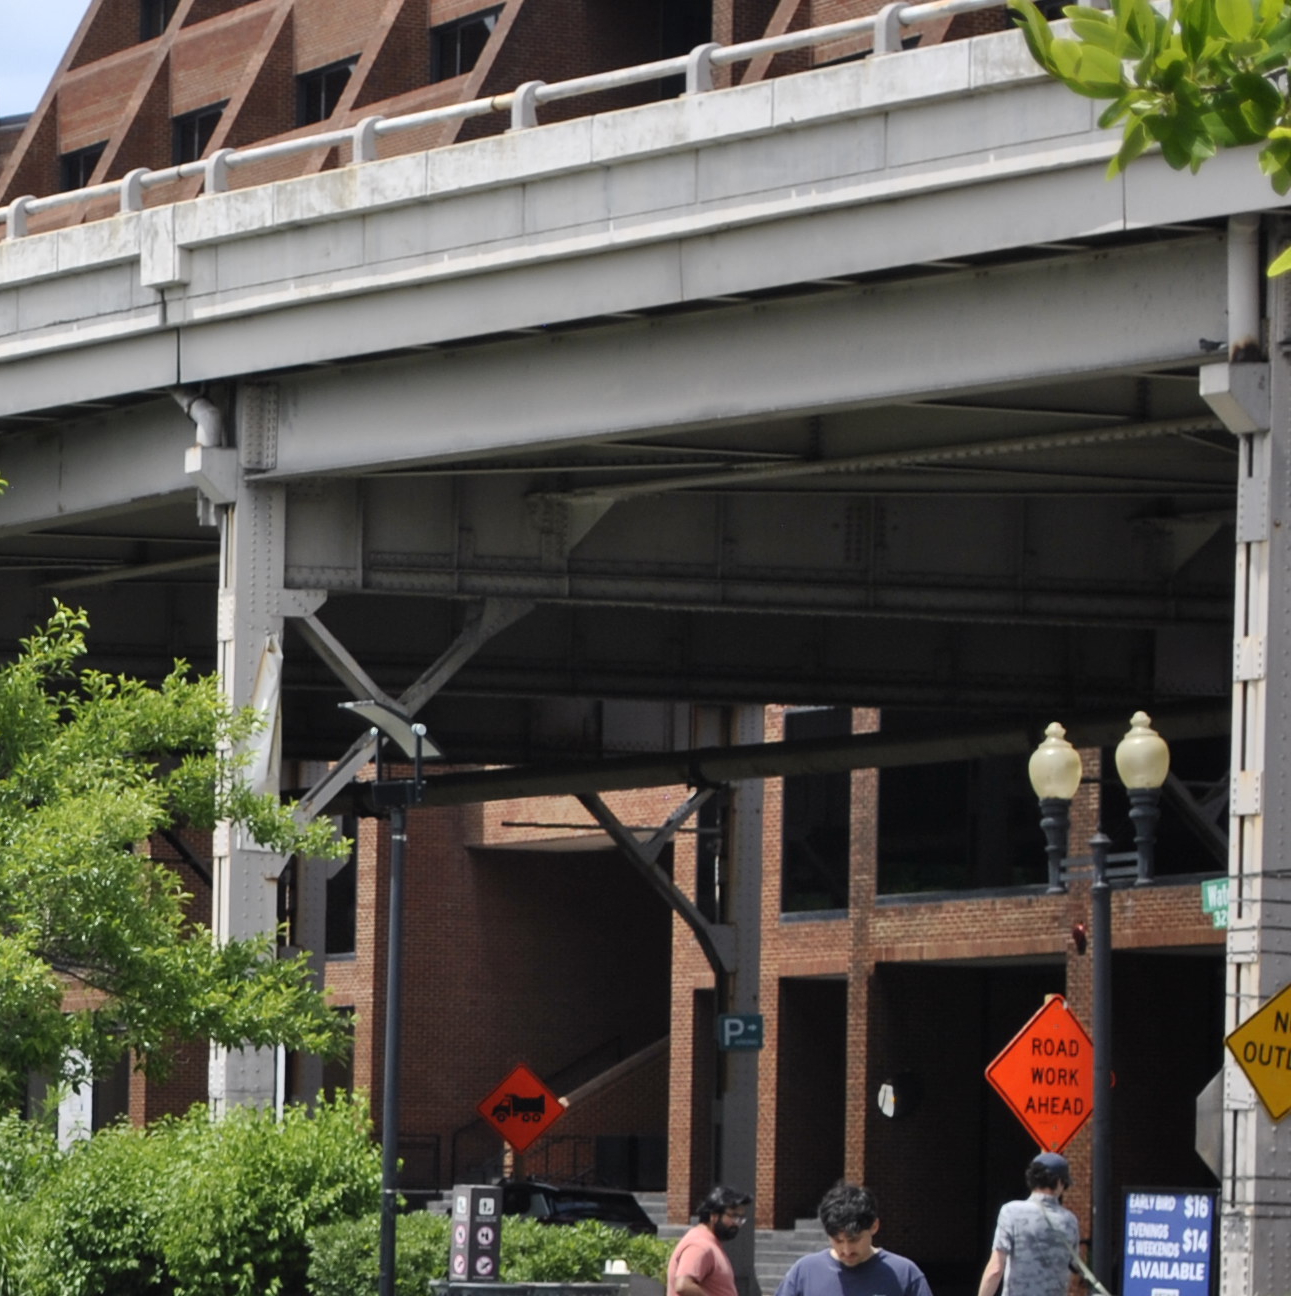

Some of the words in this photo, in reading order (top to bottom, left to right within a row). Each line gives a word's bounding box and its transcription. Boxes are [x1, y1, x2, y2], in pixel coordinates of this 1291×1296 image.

[1207, 884, 1228, 907] Wat
[1214, 910, 1228, 928] 32
[1274, 1010, 1291, 1034] N
[724, 1018, 744, 1047] P
[1032, 1037, 1080, 1057] ROAD
[1031, 1067, 1080, 1087] WORK
[1024, 1096, 1084, 1116] AHEAD
[1129, 1193, 1155, 1211] EARLY
[1155, 1195, 1176, 1212] BIRD
[1184, 1194, 1209, 1219] $16
[1128, 1221, 1169, 1240] EVENINGS
[1182, 1227, 1208, 1254] $14
[1127, 1238, 1135, 1256] &
[1135, 1240, 1181, 1258] WEEKENDS
[1130, 1260, 1205, 1281] AVAILABLE
